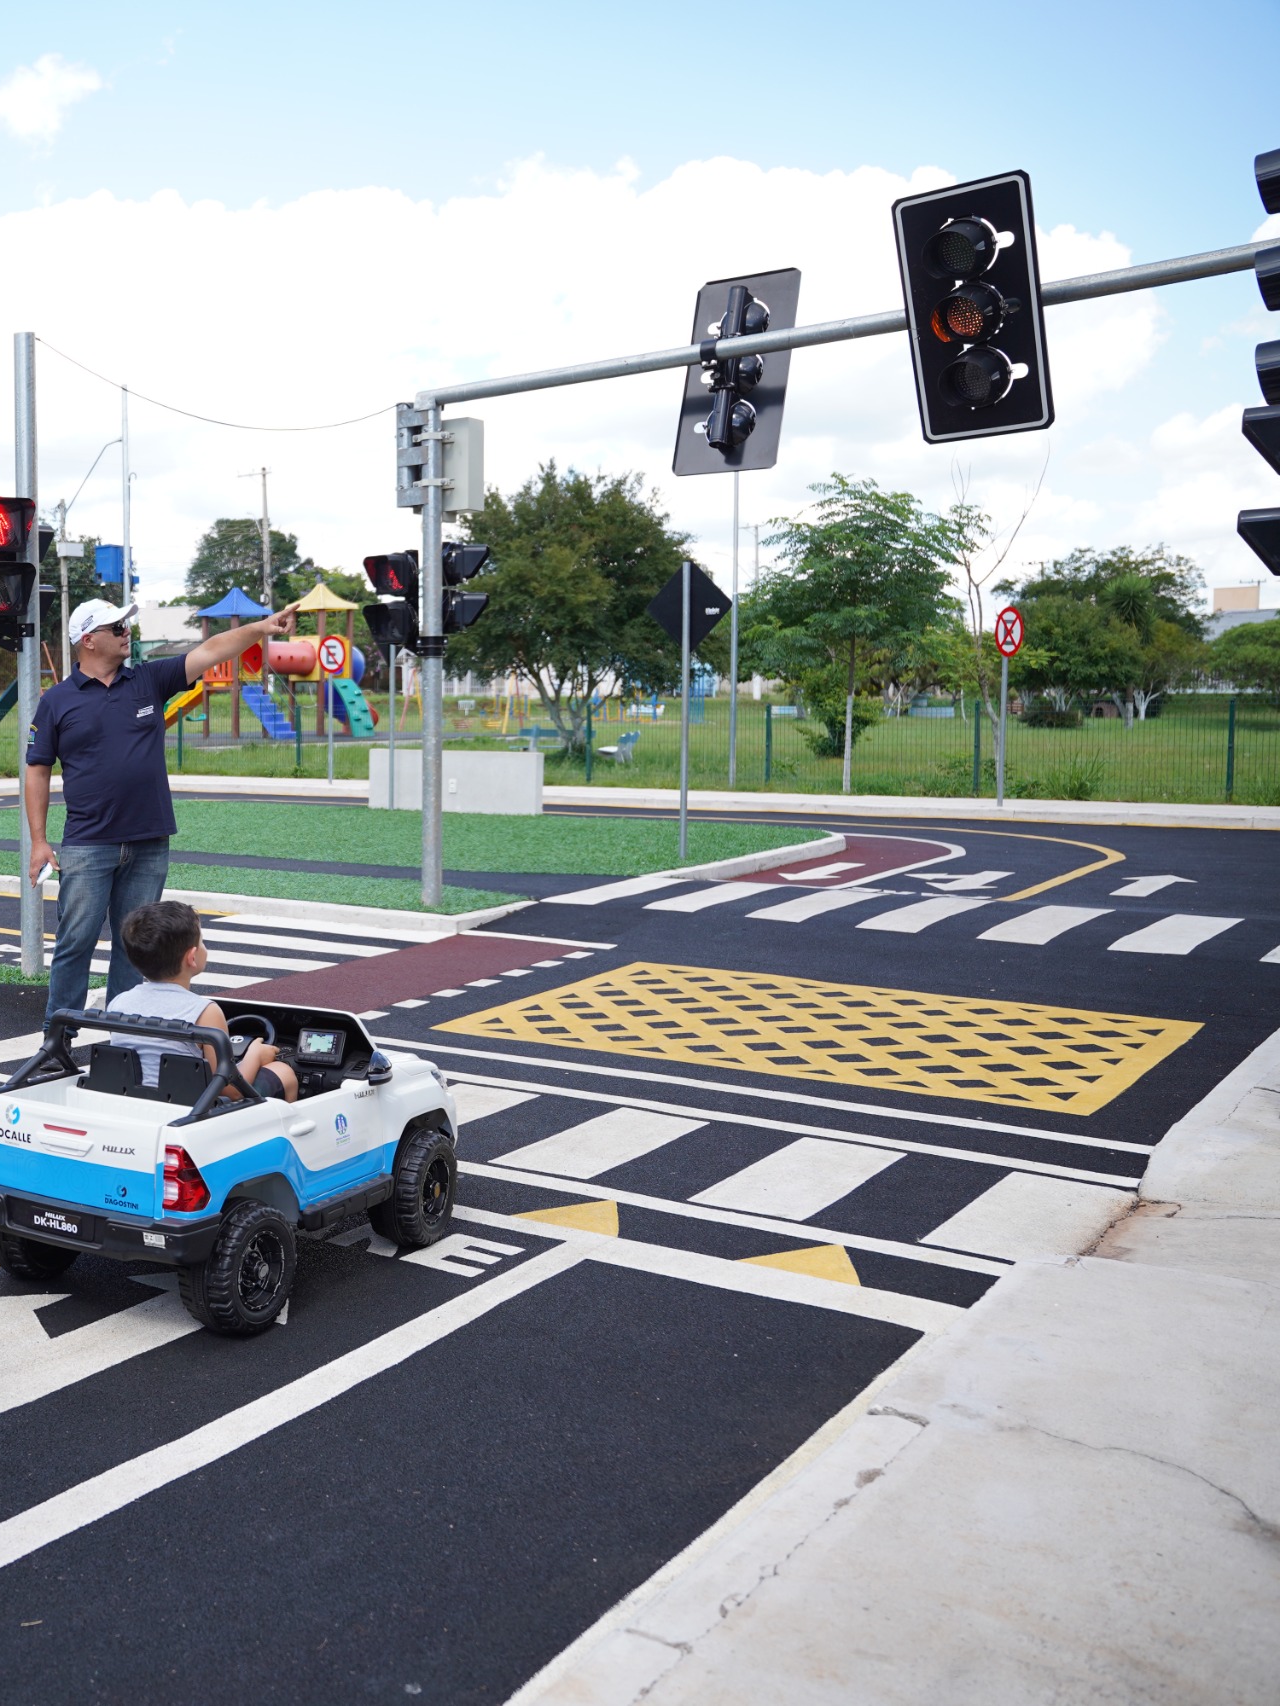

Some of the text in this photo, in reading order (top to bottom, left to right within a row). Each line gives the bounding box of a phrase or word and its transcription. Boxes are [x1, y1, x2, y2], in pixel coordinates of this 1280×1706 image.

[102, 1145, 135, 1155] HILUX
[45, 1211, 66, 1221] HILUX
[34, 1215, 78, 1234] DK-HL860
